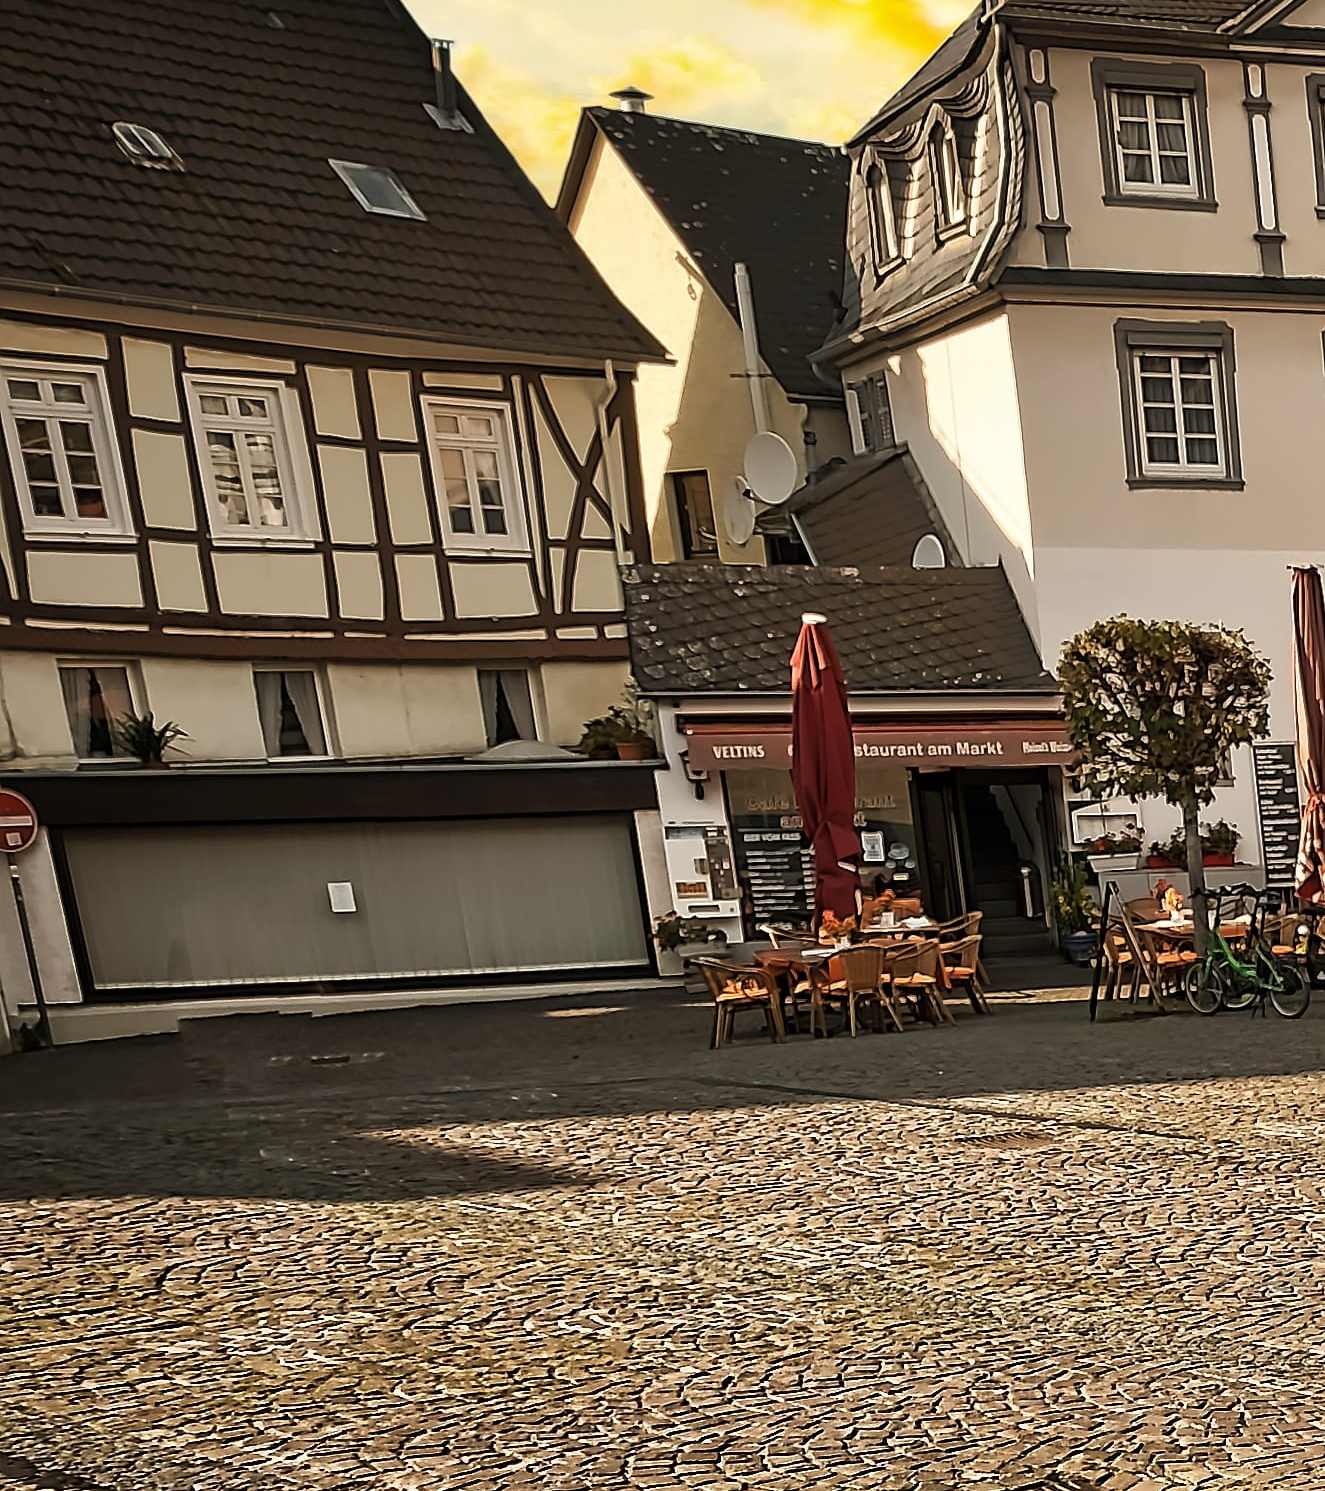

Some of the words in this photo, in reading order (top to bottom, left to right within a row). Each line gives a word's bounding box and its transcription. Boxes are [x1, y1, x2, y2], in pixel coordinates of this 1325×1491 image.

[712, 744, 765, 759] VELTINS
[854, 742, 924, 758] staurant
[928, 745, 951, 757] am
[956, 741, 1004, 756] Markt
